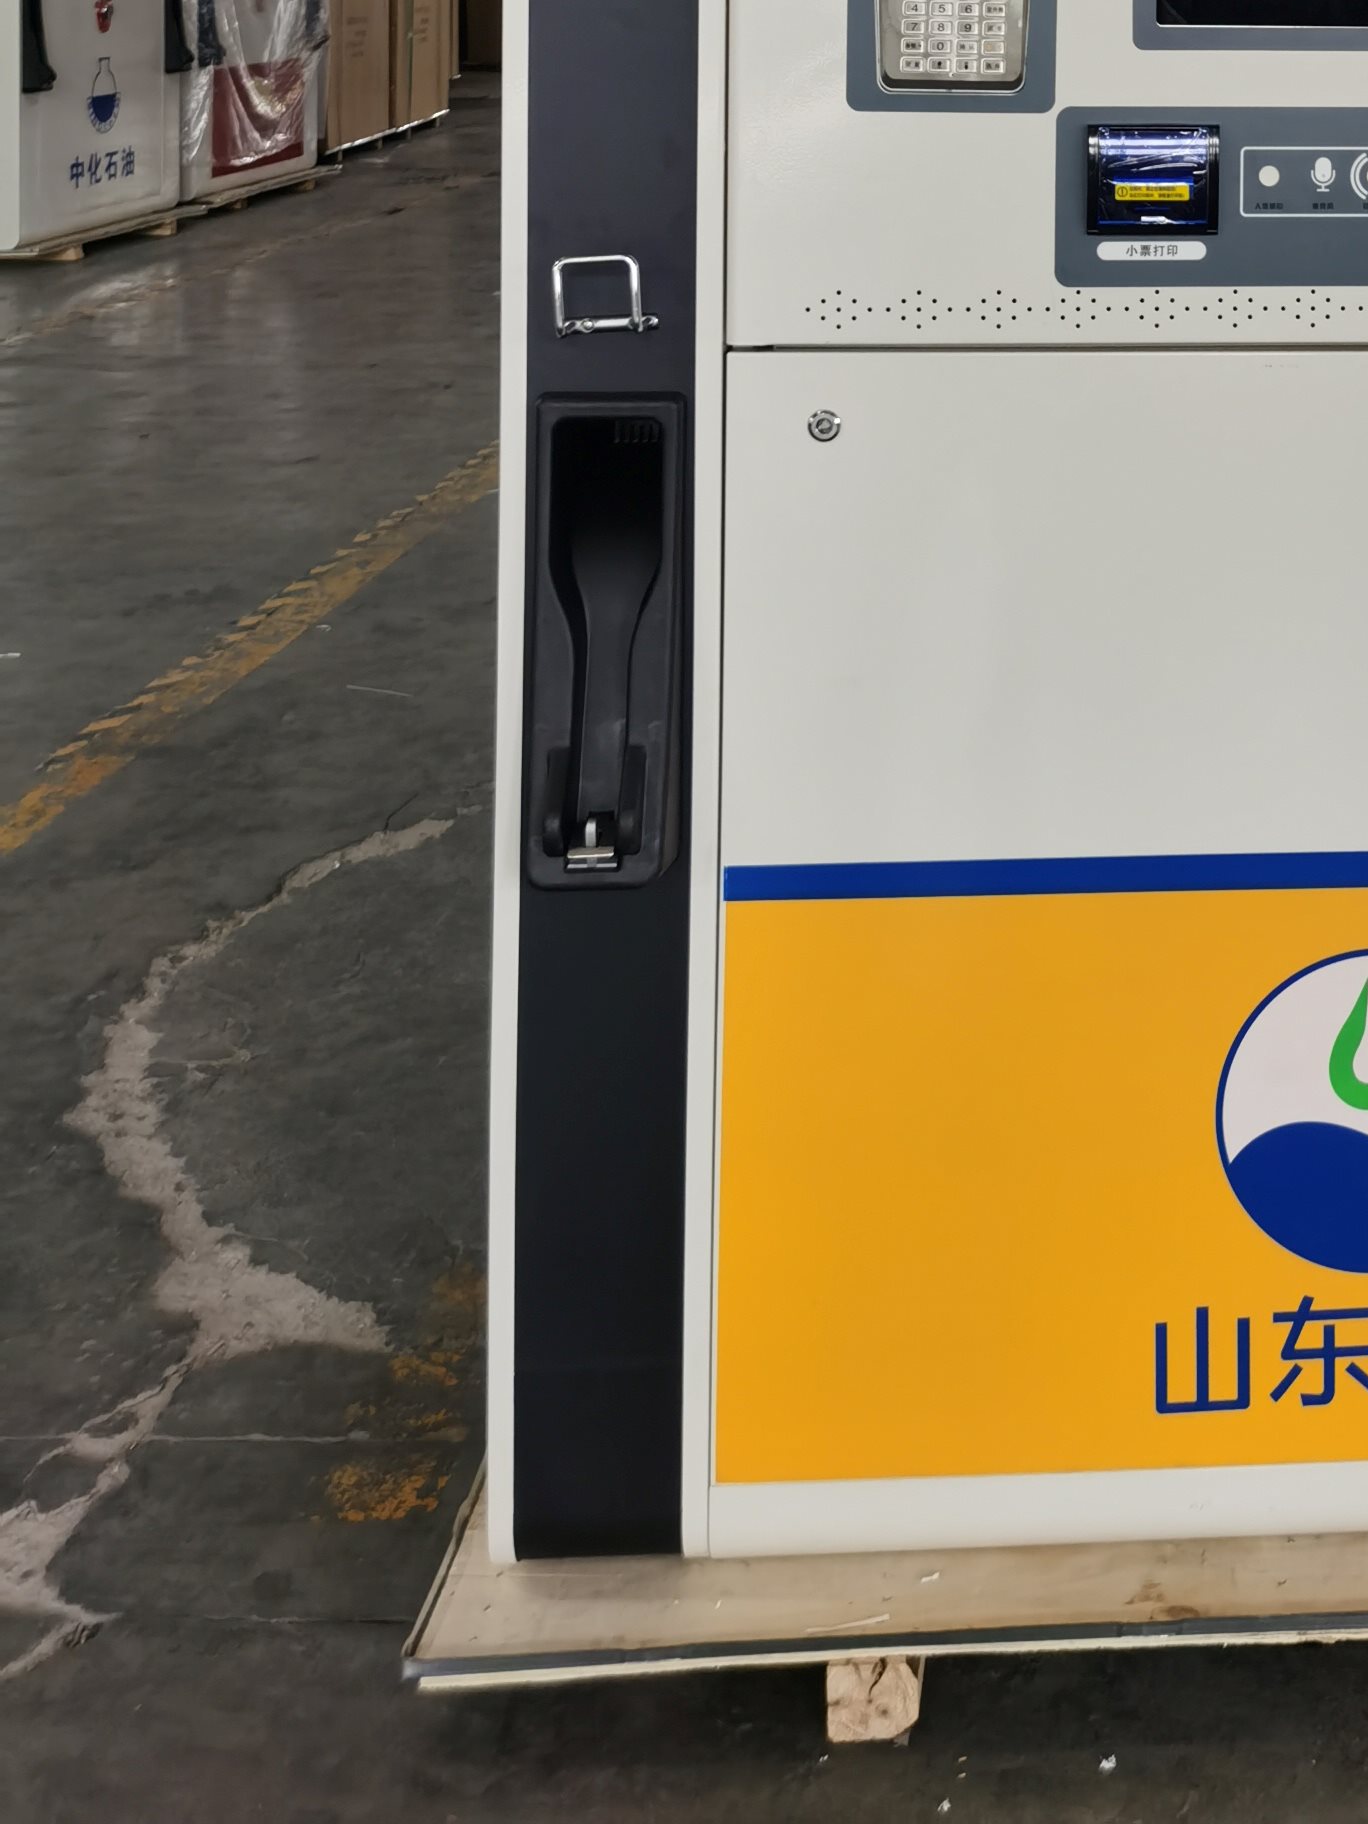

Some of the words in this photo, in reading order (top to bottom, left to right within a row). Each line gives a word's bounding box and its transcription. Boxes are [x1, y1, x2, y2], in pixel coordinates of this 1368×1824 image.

[911, 4, 918, 12] 4
[938, 5, 945, 13] 5
[965, 5, 972, 13] 6
[911, 23, 917, 31] 7
[938, 23, 944, 31] 8
[965, 24, 971, 32] 9
[937, 42, 944, 50] 0
[70, 145, 135, 189] 中化石油
[1126, 244, 1178, 257] 小票打印
